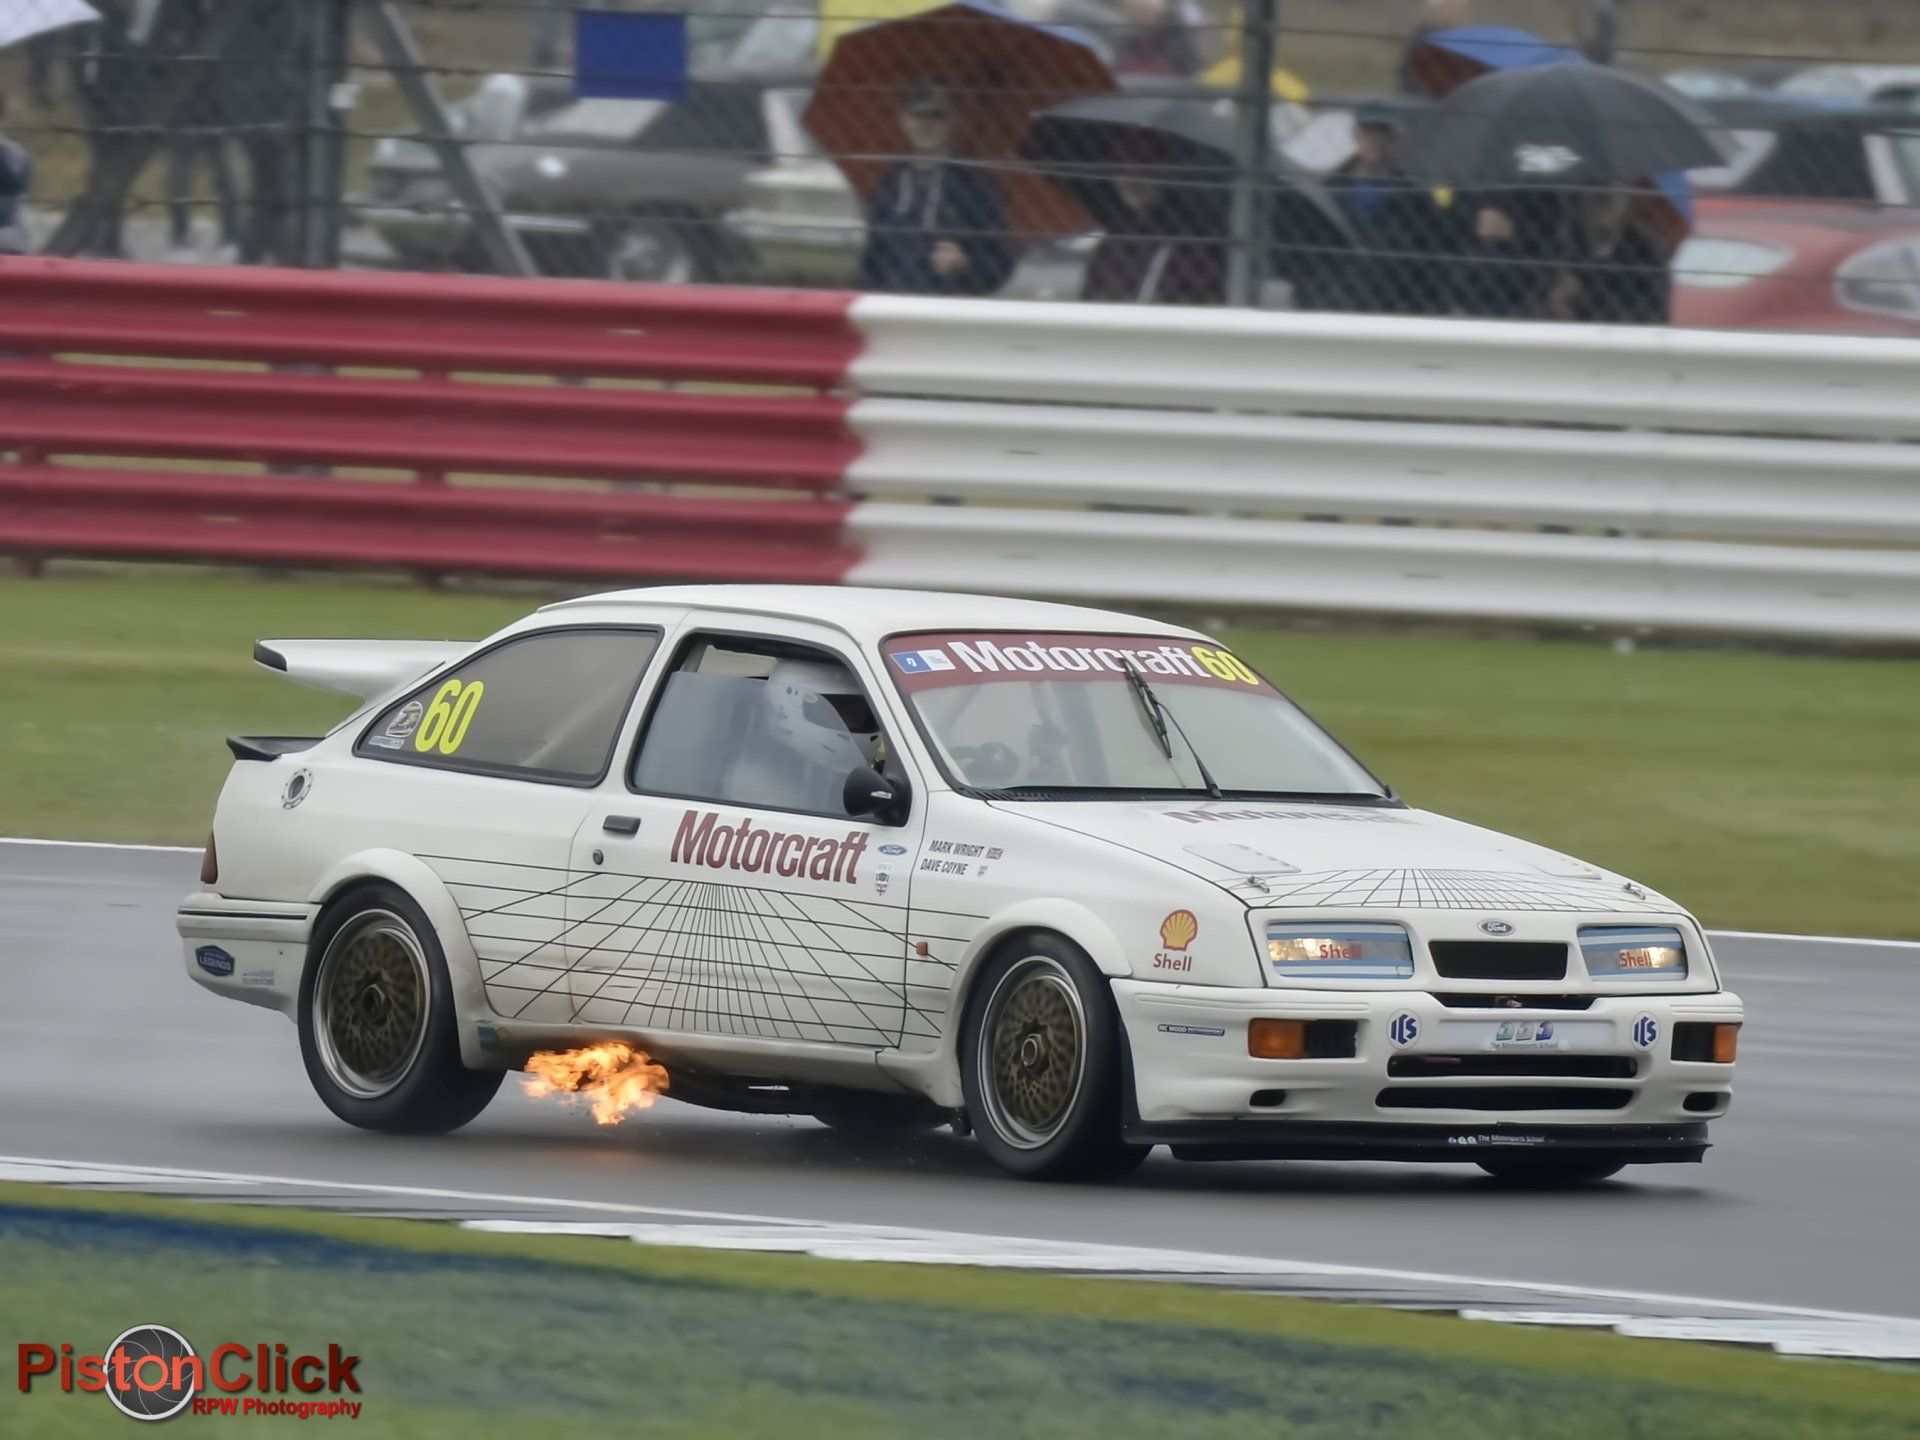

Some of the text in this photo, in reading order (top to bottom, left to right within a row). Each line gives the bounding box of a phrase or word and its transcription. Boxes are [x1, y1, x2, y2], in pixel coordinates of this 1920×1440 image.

[947, 640, 1260, 685] Motorcraft 60
[415, 679, 484, 755] 60
[670, 809, 870, 884] Motorcraft
[928, 840, 985, 857] MARK WRIGHT
[920, 859, 968, 875] DAVE COYNE
[1485, 922, 1509, 933] Ford
[1153, 953, 1193, 971] Shell
[1618, 952, 1652, 968] Shell
